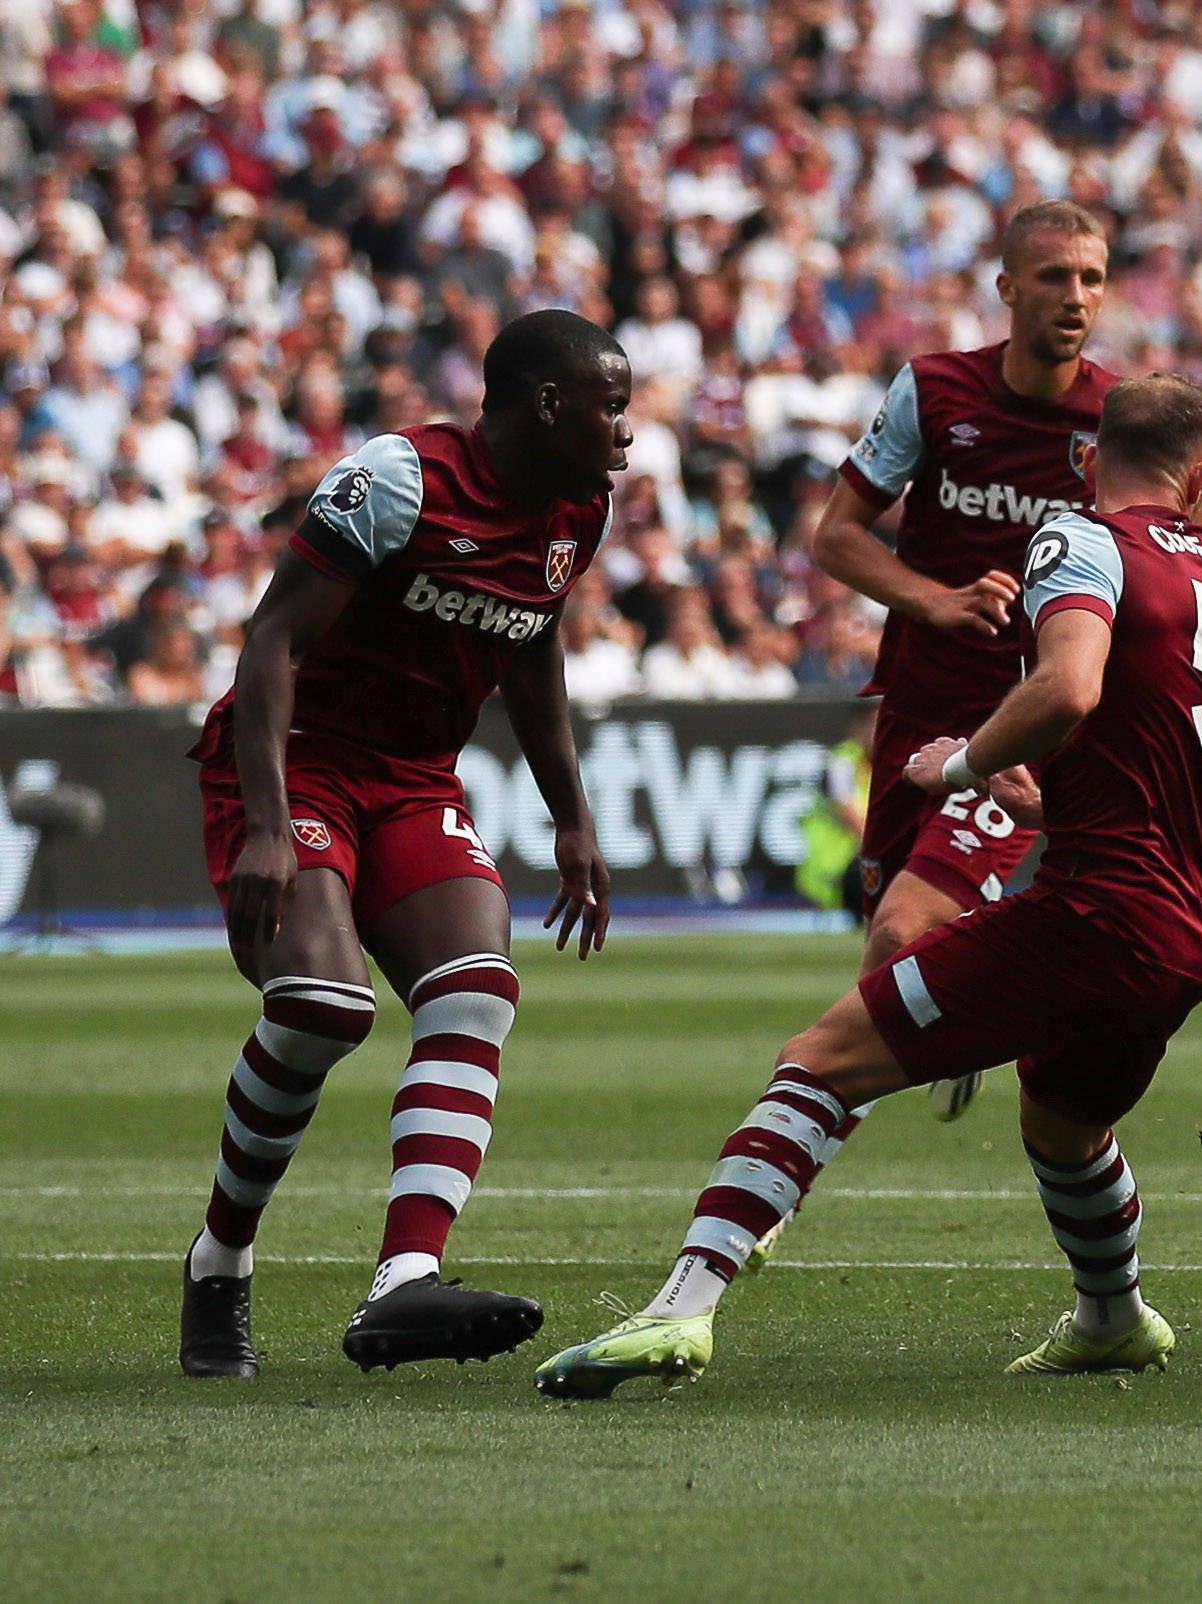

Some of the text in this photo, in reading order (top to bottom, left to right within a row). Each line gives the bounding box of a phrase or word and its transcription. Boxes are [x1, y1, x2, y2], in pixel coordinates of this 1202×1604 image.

[938, 467, 1097, 527] betwa
[402, 573, 554, 647] betway
[441, 807, 485, 850] 4
[455, 720, 832, 870] etwa
